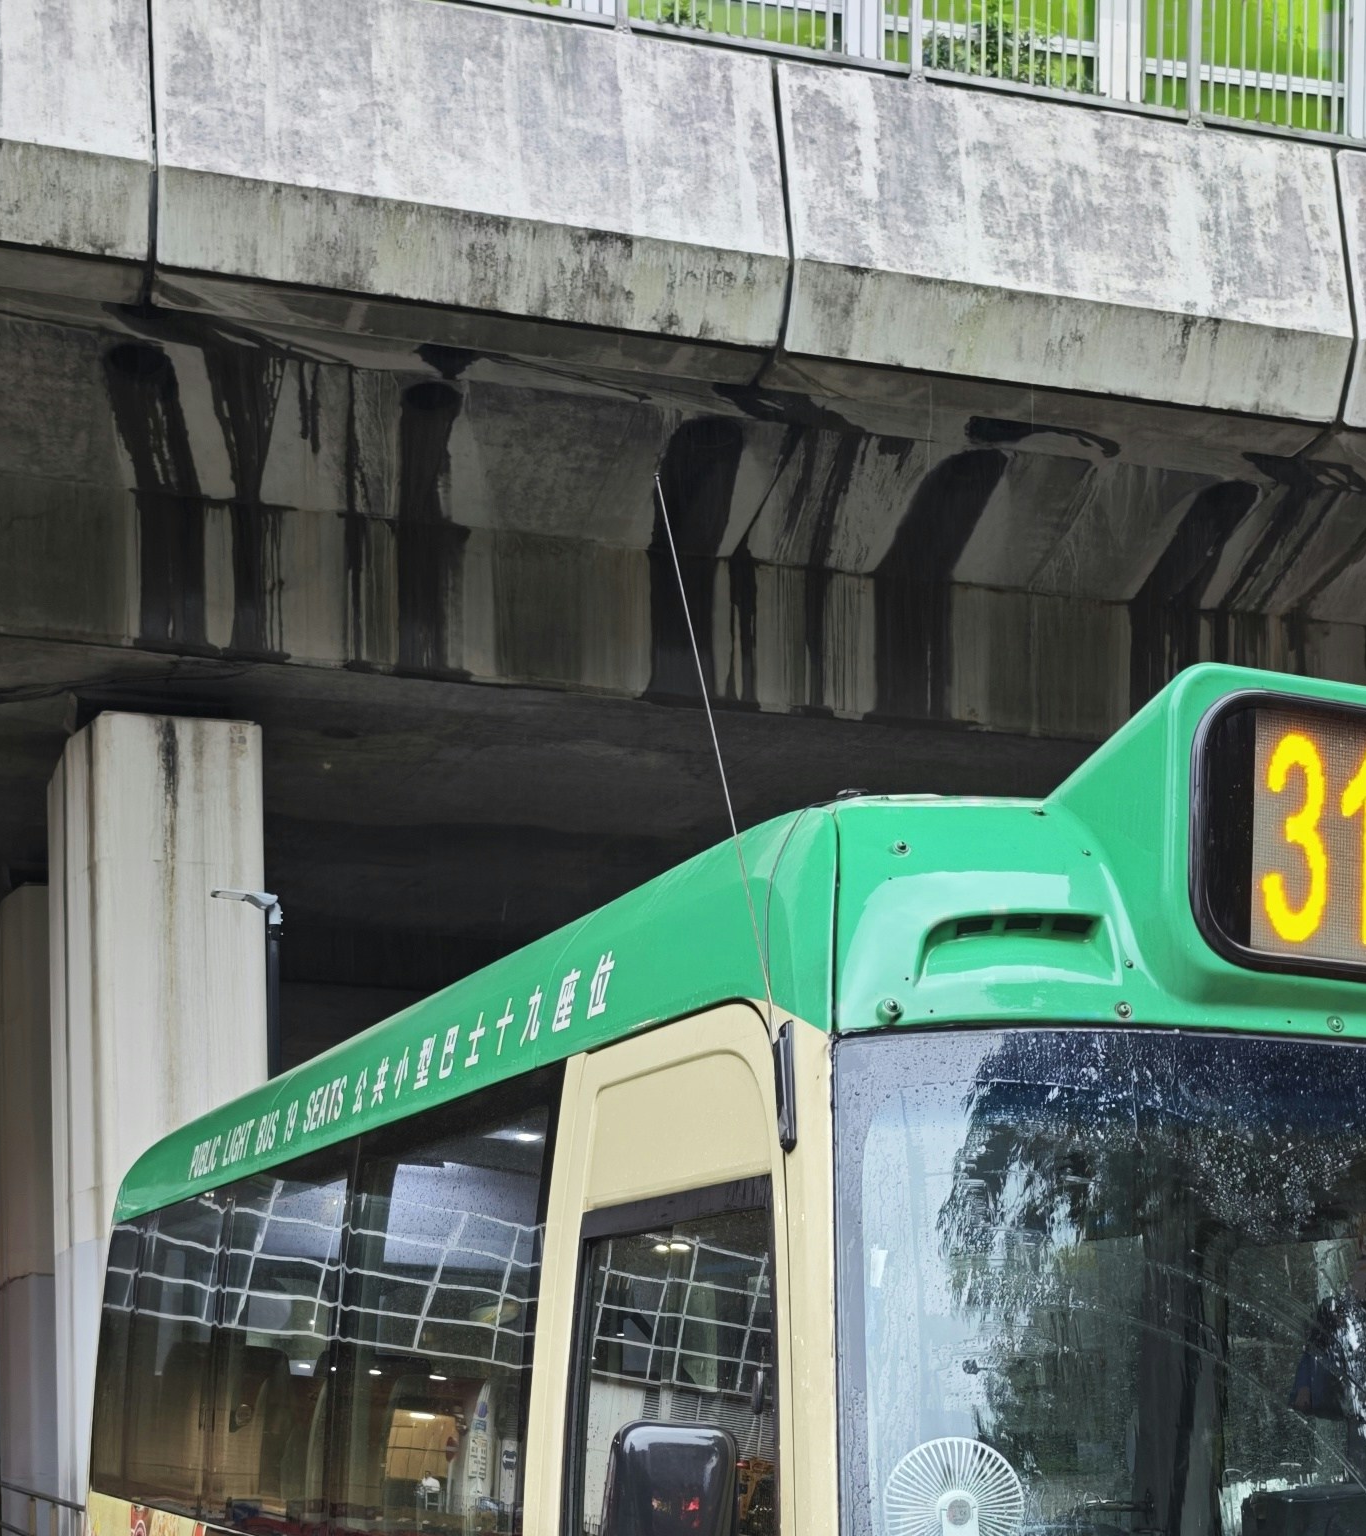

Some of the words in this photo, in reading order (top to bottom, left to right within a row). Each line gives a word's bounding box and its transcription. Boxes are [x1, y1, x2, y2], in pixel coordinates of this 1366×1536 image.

[188, 1135, 222, 1180] PUBLIC
[222, 1119, 255, 1167] LIGHT
[255, 1109, 280, 1155] BUS
[283, 1100, 299, 1143] 19
[303, 1075, 348, 1133] SEATS
